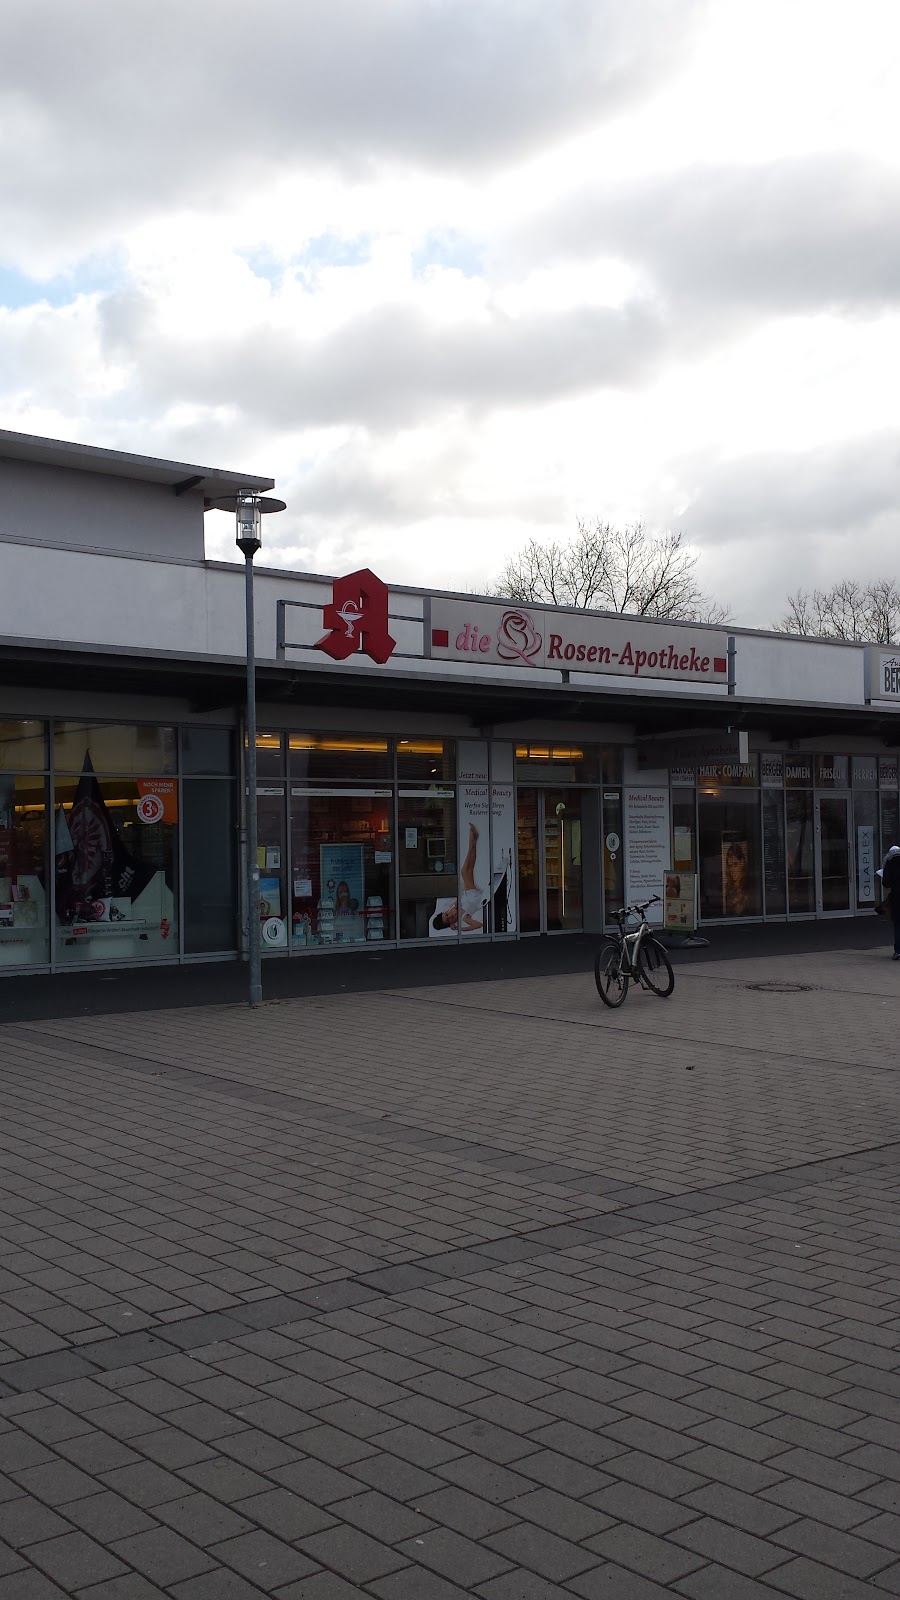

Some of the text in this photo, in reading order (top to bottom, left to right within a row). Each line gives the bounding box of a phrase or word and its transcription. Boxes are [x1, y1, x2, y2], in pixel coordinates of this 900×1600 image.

[455, 623, 711, 674] die Rosen-Apotheke
[459, 771, 474, 779] Jetzt
[786, 766, 810, 778] DAMEN
[819, 767, 847, 780] FRISEUR
[853, 768, 878, 780] HERREN
[465, 788, 512, 798] Medical Beauty
[628, 794, 665, 802] Medical Beauty
[862, 831, 871, 897] OLAPLEX
